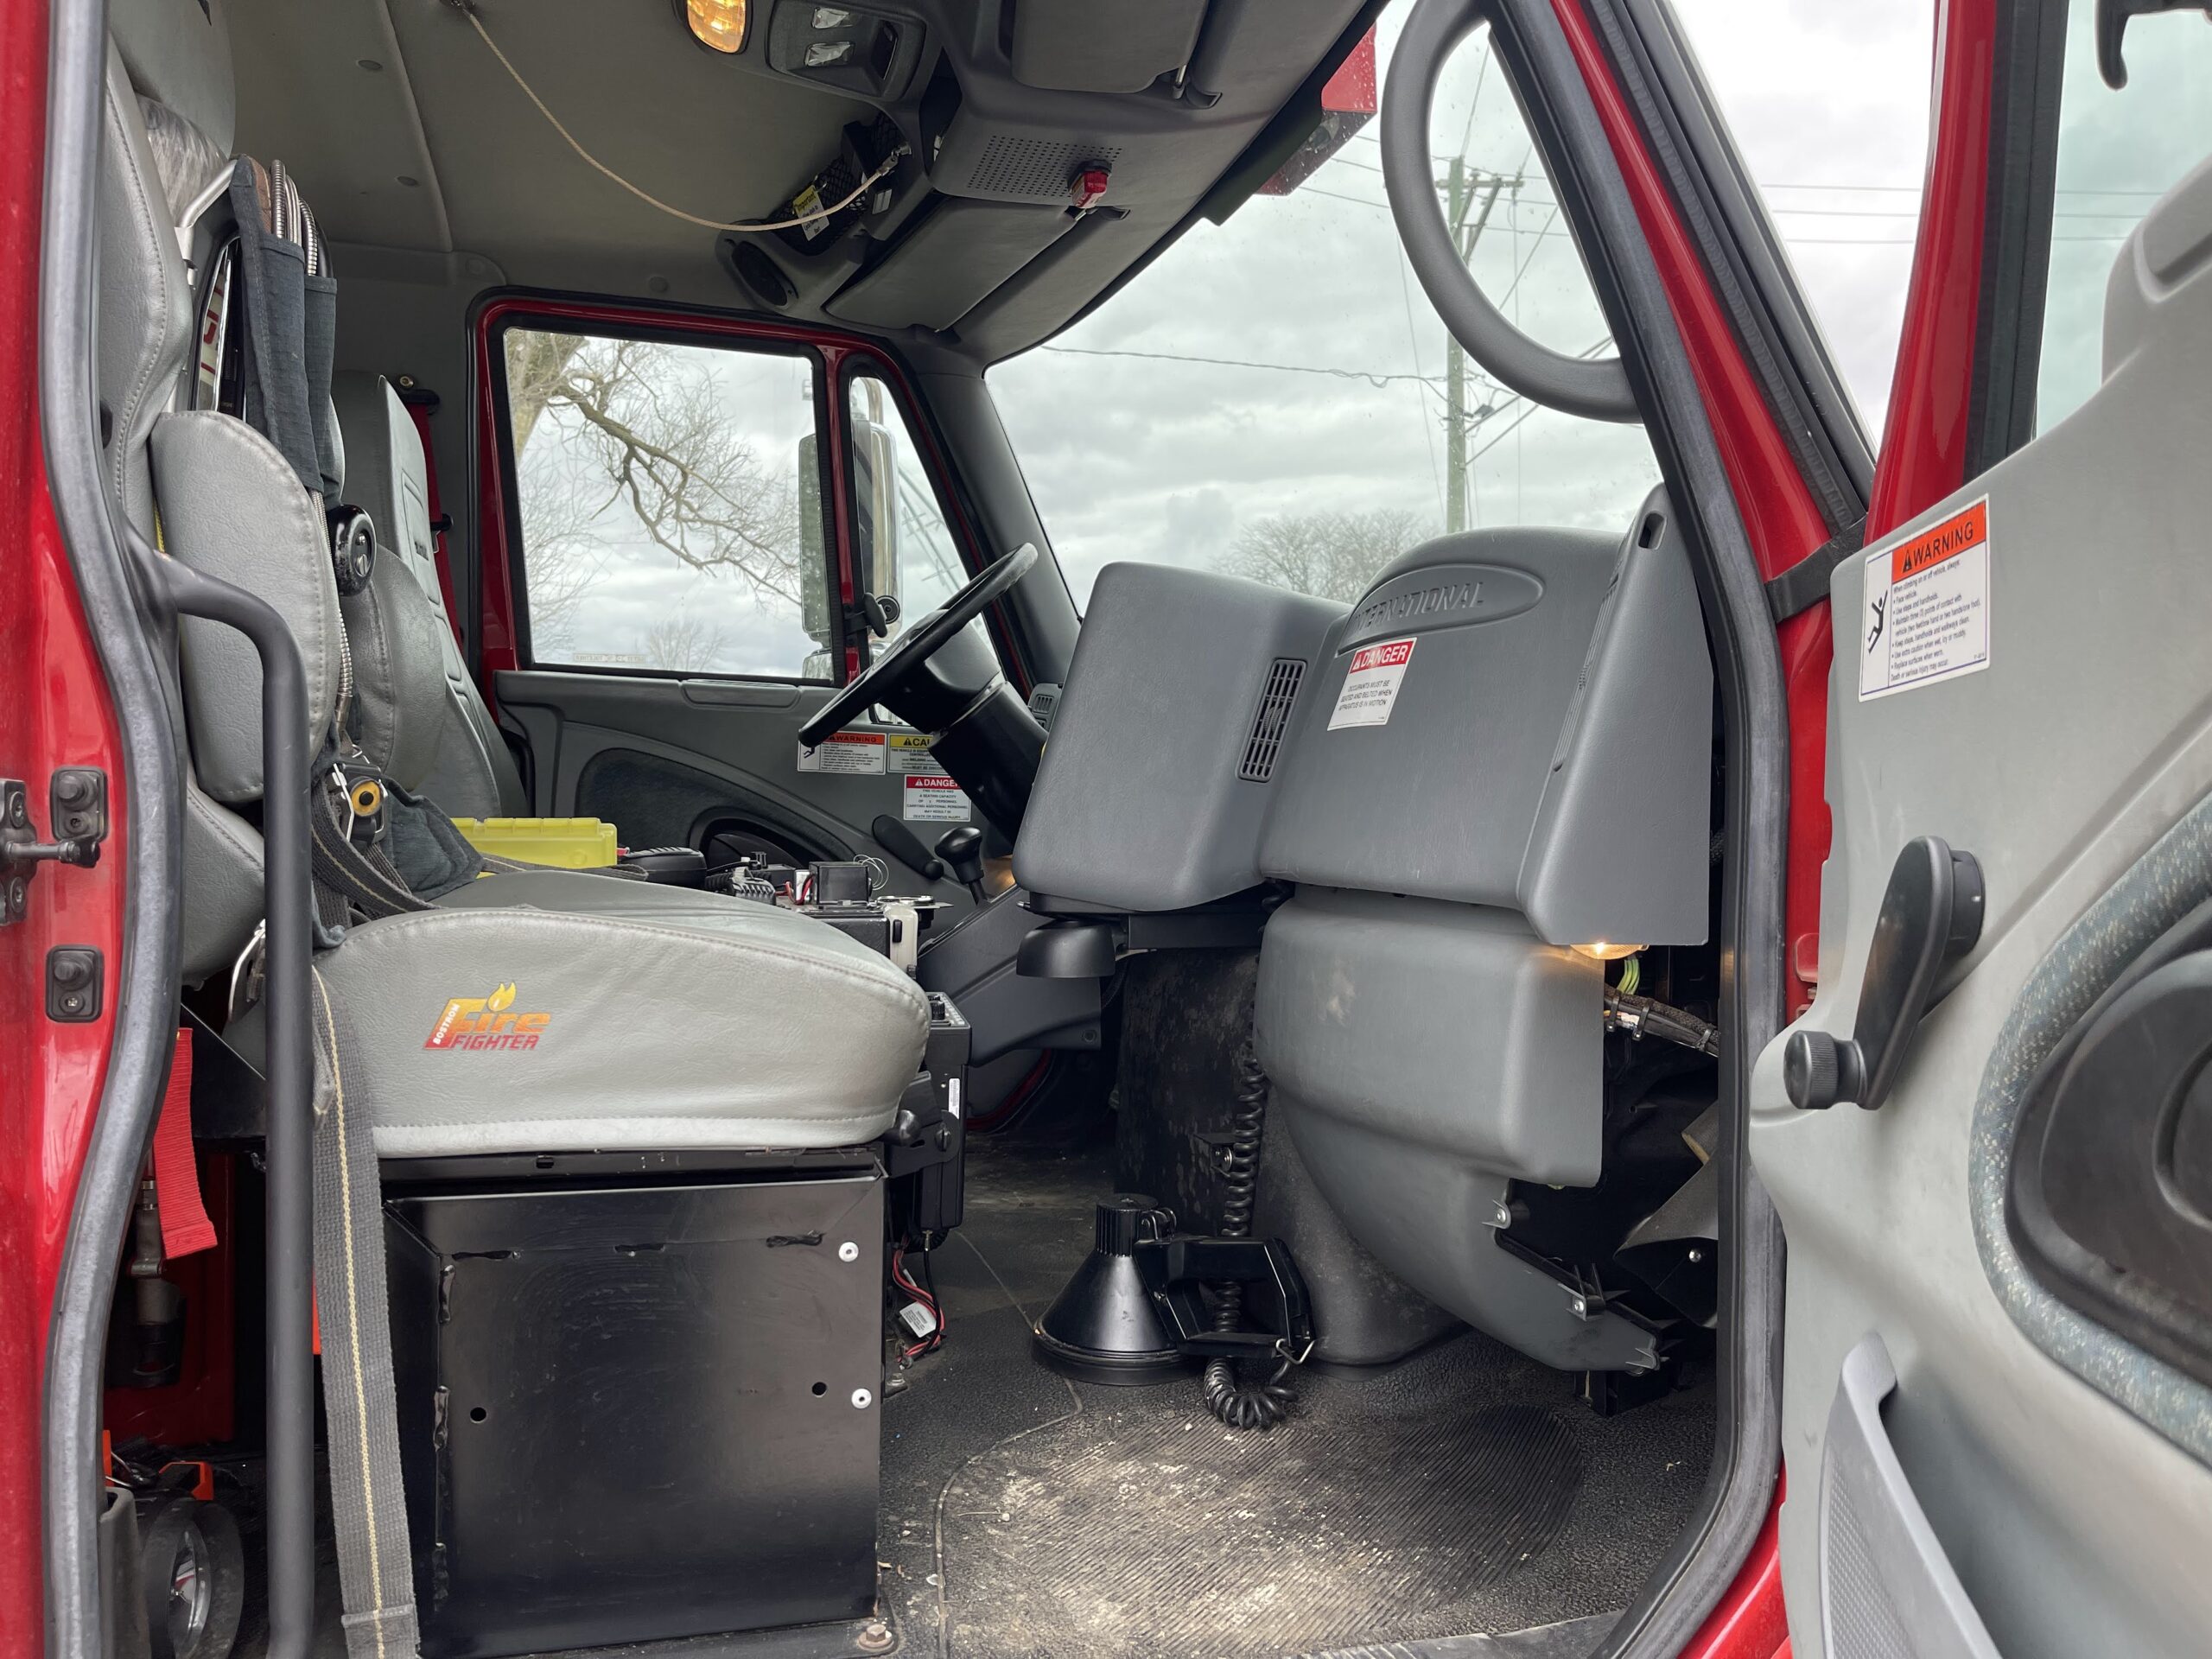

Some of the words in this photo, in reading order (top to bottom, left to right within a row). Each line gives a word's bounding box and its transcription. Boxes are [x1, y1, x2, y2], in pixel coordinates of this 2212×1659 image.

[1913, 521, 1974, 567] WARNING
[1352, 582, 1484, 632] INTERNATIONAL
[1360, 645, 1408, 668] DANGER
[449, 1034, 540, 1051] FIGHTER
